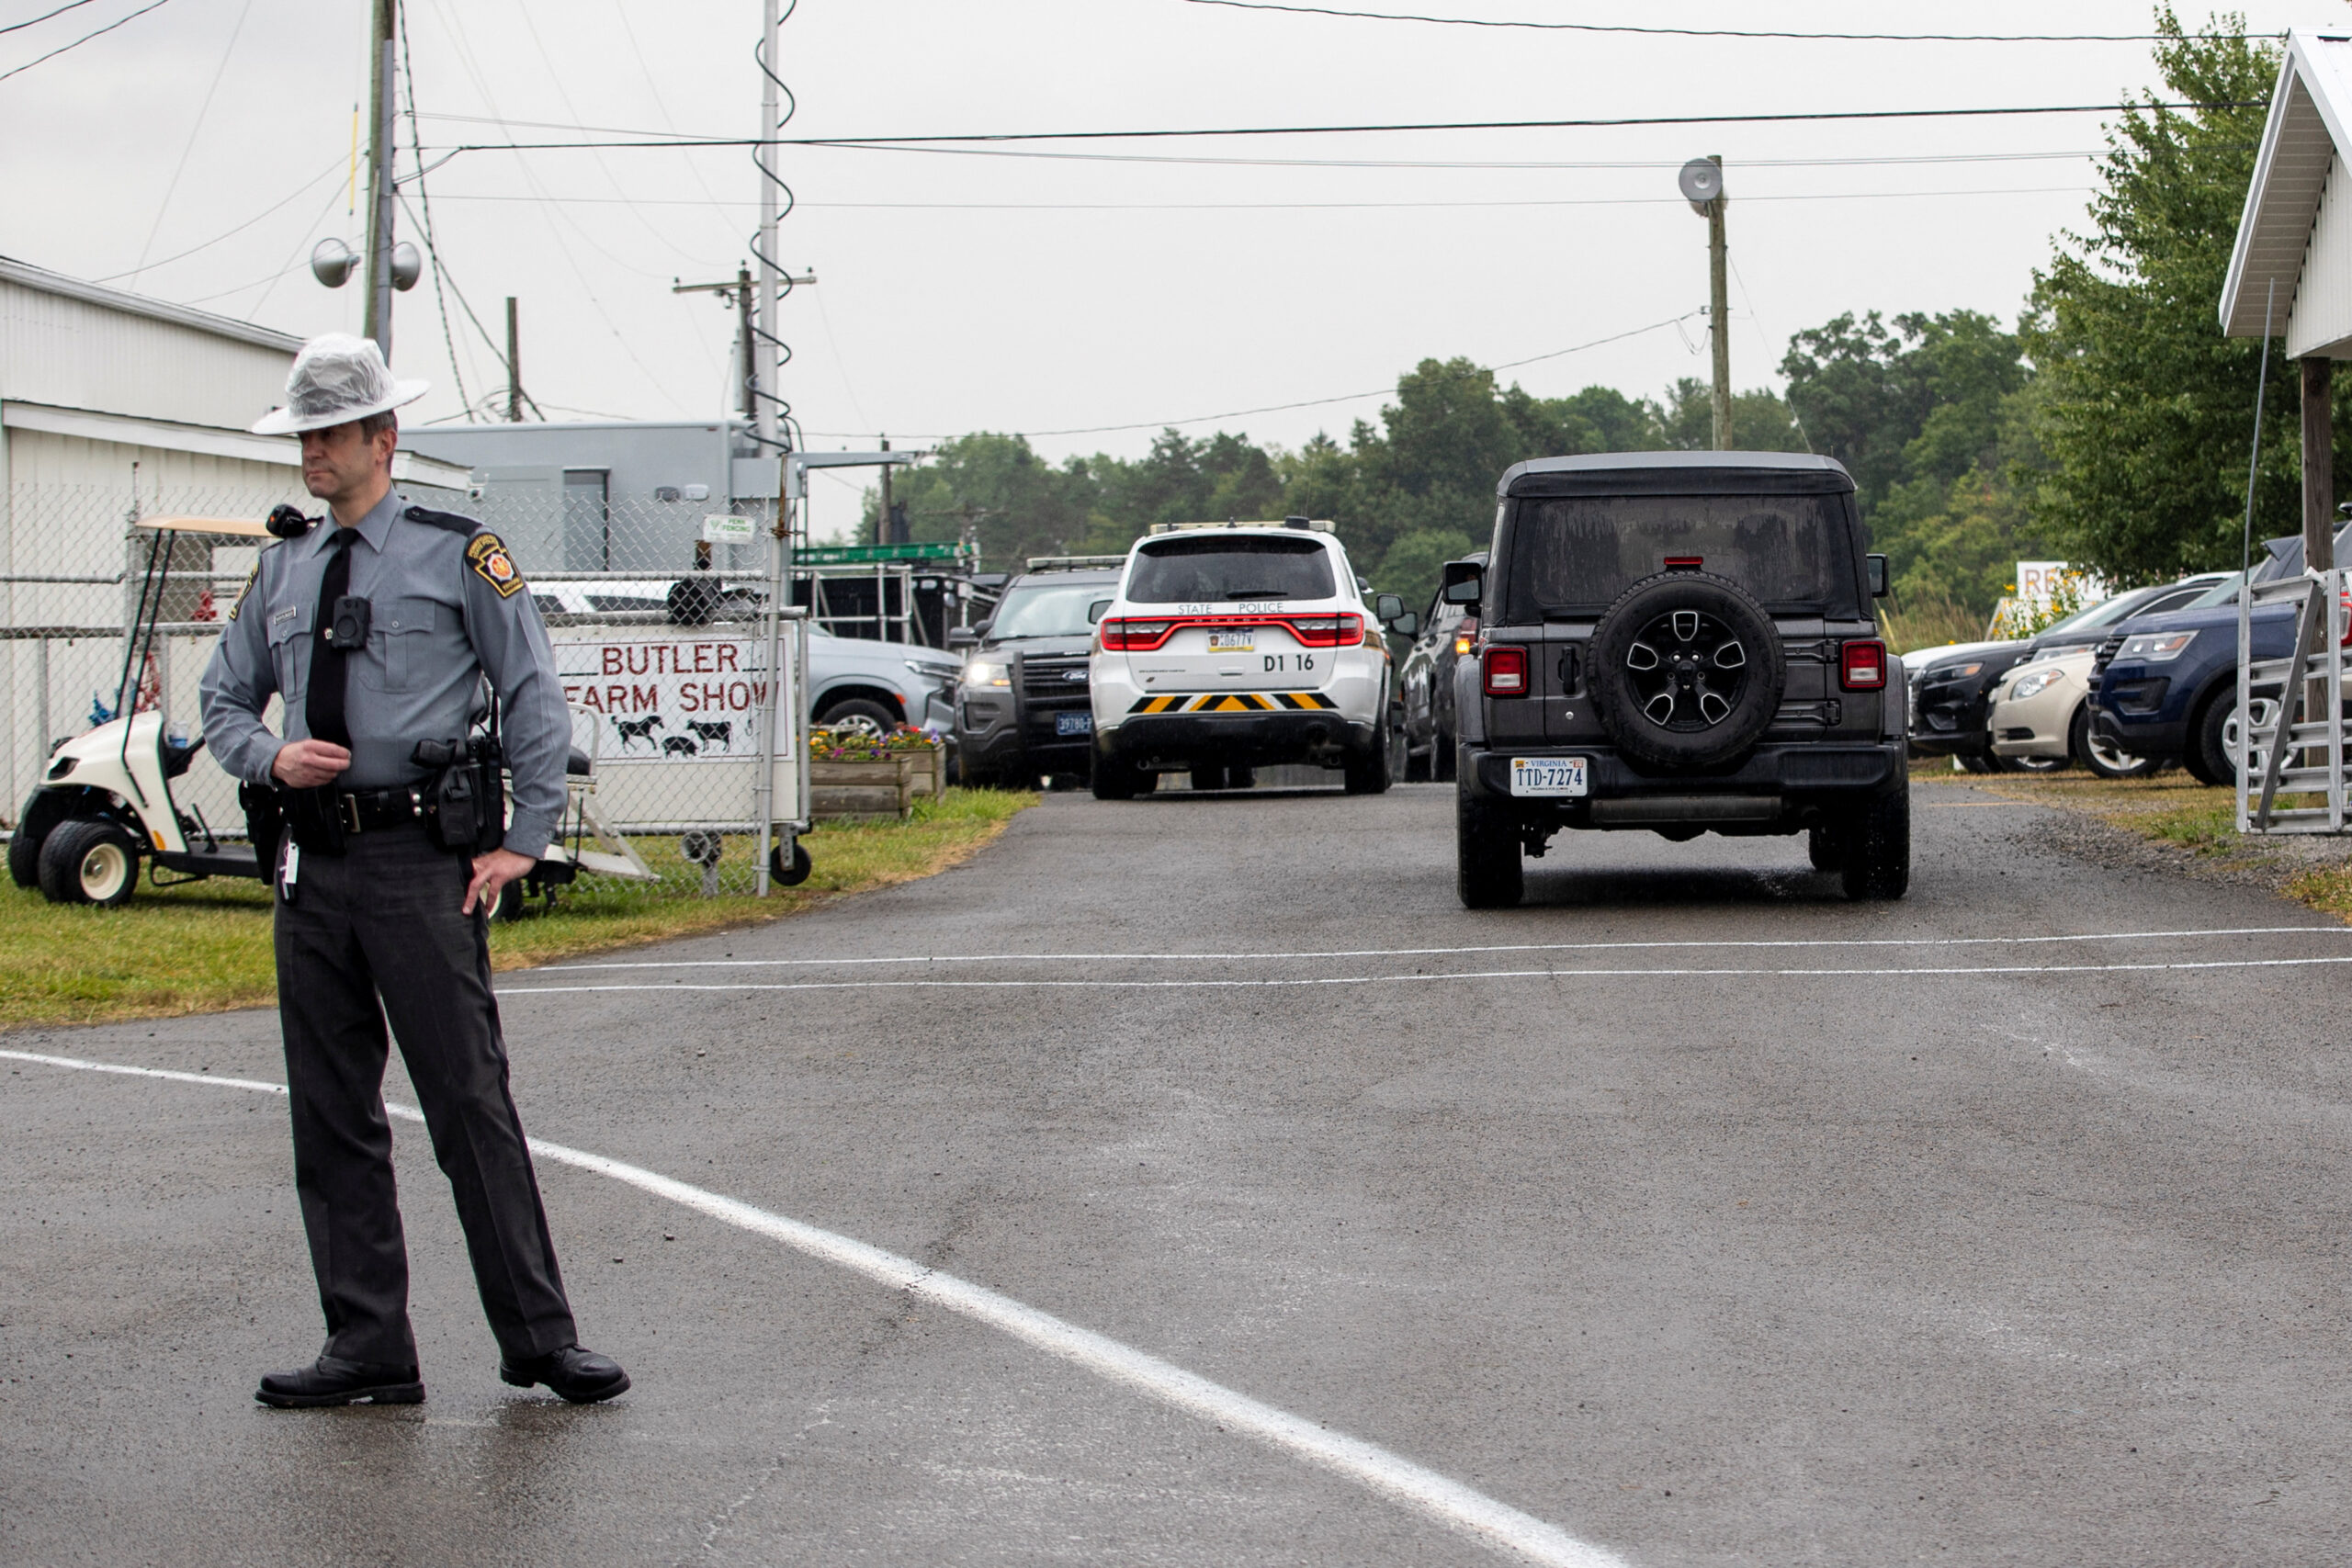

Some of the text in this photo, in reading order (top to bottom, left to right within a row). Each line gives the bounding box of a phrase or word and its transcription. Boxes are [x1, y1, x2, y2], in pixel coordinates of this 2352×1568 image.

[1178, 602, 1284, 615] STATE POLICE
[602, 644, 739, 676] BUTLER
[1263, 654, 1315, 672] D1 16
[562, 681, 780, 715] FARM SHOW
[1531, 760, 1567, 768] VIRGINIA
[1516, 768, 1583, 786] TTD-7274
